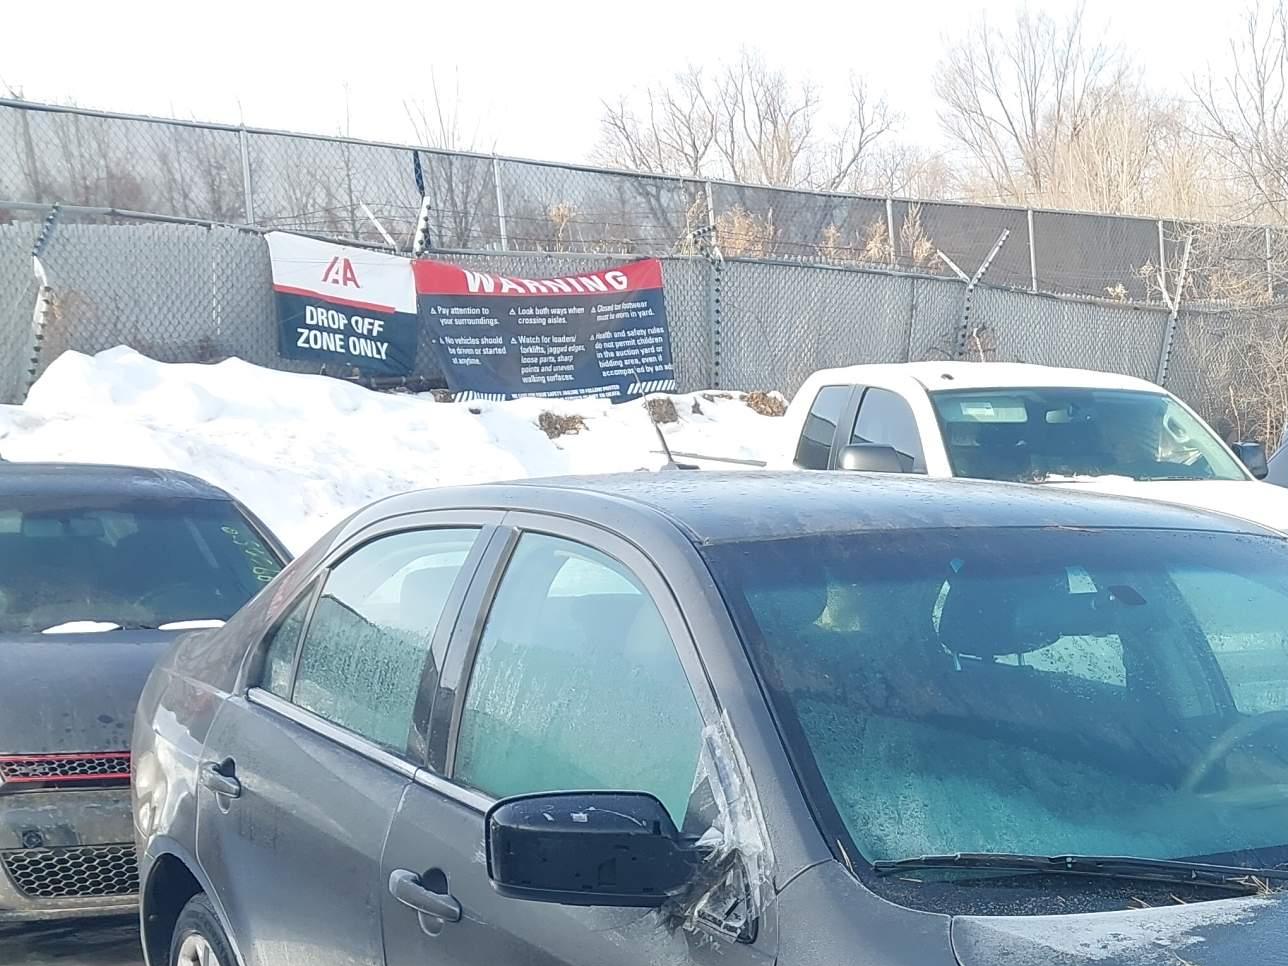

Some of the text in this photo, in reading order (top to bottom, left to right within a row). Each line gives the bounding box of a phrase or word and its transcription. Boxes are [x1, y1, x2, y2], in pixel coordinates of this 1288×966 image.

[463, 270, 628, 293] WARNING
[437, 306, 449, 316] Pay
[518, 306, 534, 315] Look
[535, 306, 549, 315] both
[638, 308, 655, 318] yard.
[306, 306, 384, 336] DROP OFF
[455, 317, 499, 326] surroundings.
[518, 317, 546, 325] crossing
[614, 330, 625, 338] and
[627, 328, 646, 336] safety
[648, 326, 664, 334] rules
[297, 329, 388, 360] ZONE ONLY
[455, 336, 479, 344] vehicles
[481, 336, 502, 344] should
[615, 339, 636, 349] permit
[637, 336, 663, 345] children
[547, 345, 567, 354] jagged
[640, 345, 655, 355] yard
[521, 366, 539, 375] points
[602, 367, 644, 376] accompaed
[522, 374, 574, 383] walking surfaces.
